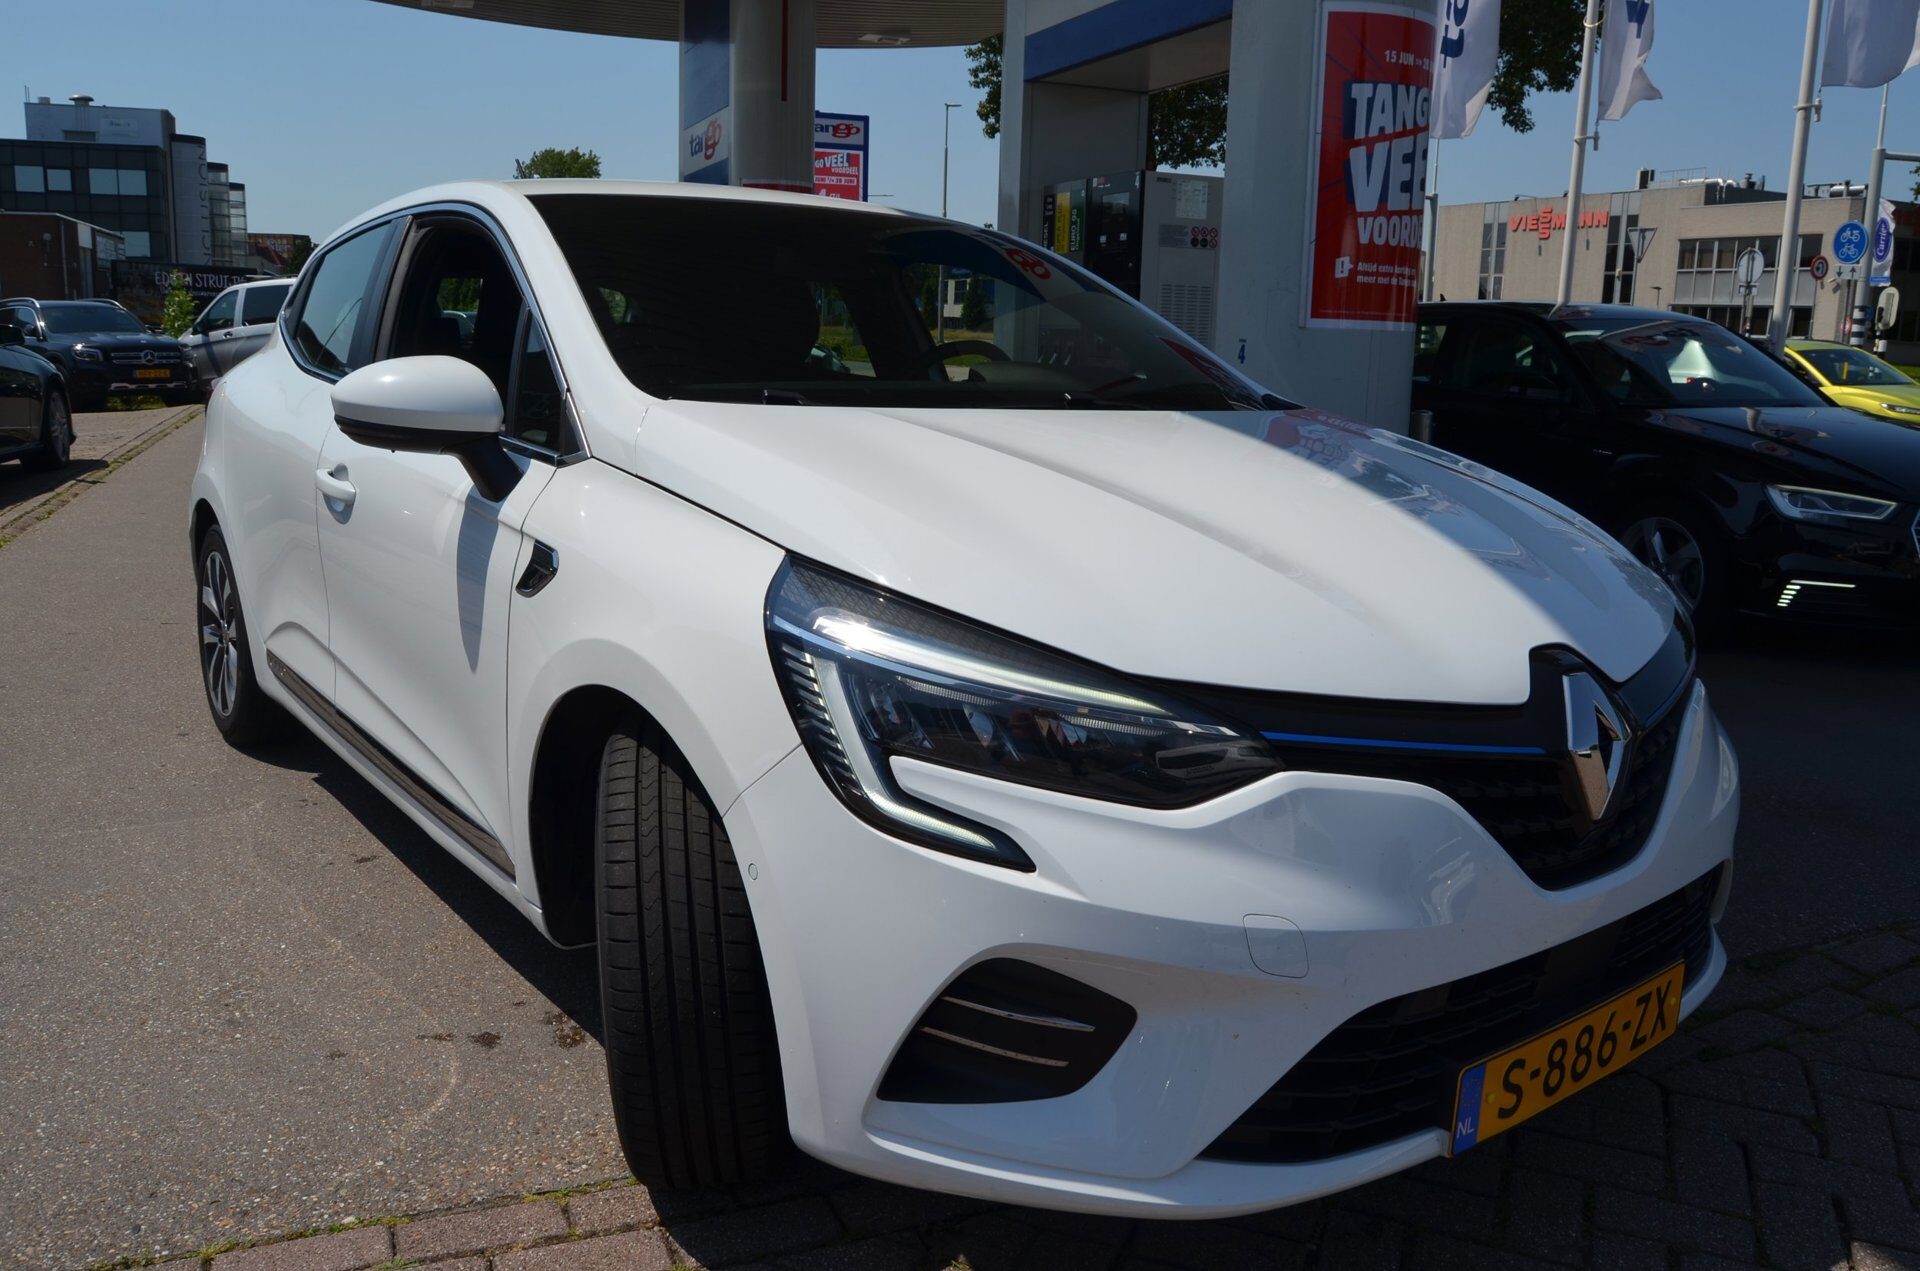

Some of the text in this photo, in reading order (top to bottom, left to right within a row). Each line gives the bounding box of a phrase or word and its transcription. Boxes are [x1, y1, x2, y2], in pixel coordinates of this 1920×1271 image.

[1351, 83, 1429, 140] TANG
[815, 122, 861, 138] ango
[824, 152, 849, 168] VEEL
[1349, 131, 1427, 213] VEE
[1509, 206, 1609, 239] VIESSMNN
[1497, 979, 1673, 1119] S-886-ZX
[1456, 1117, 1475, 1139] NL
